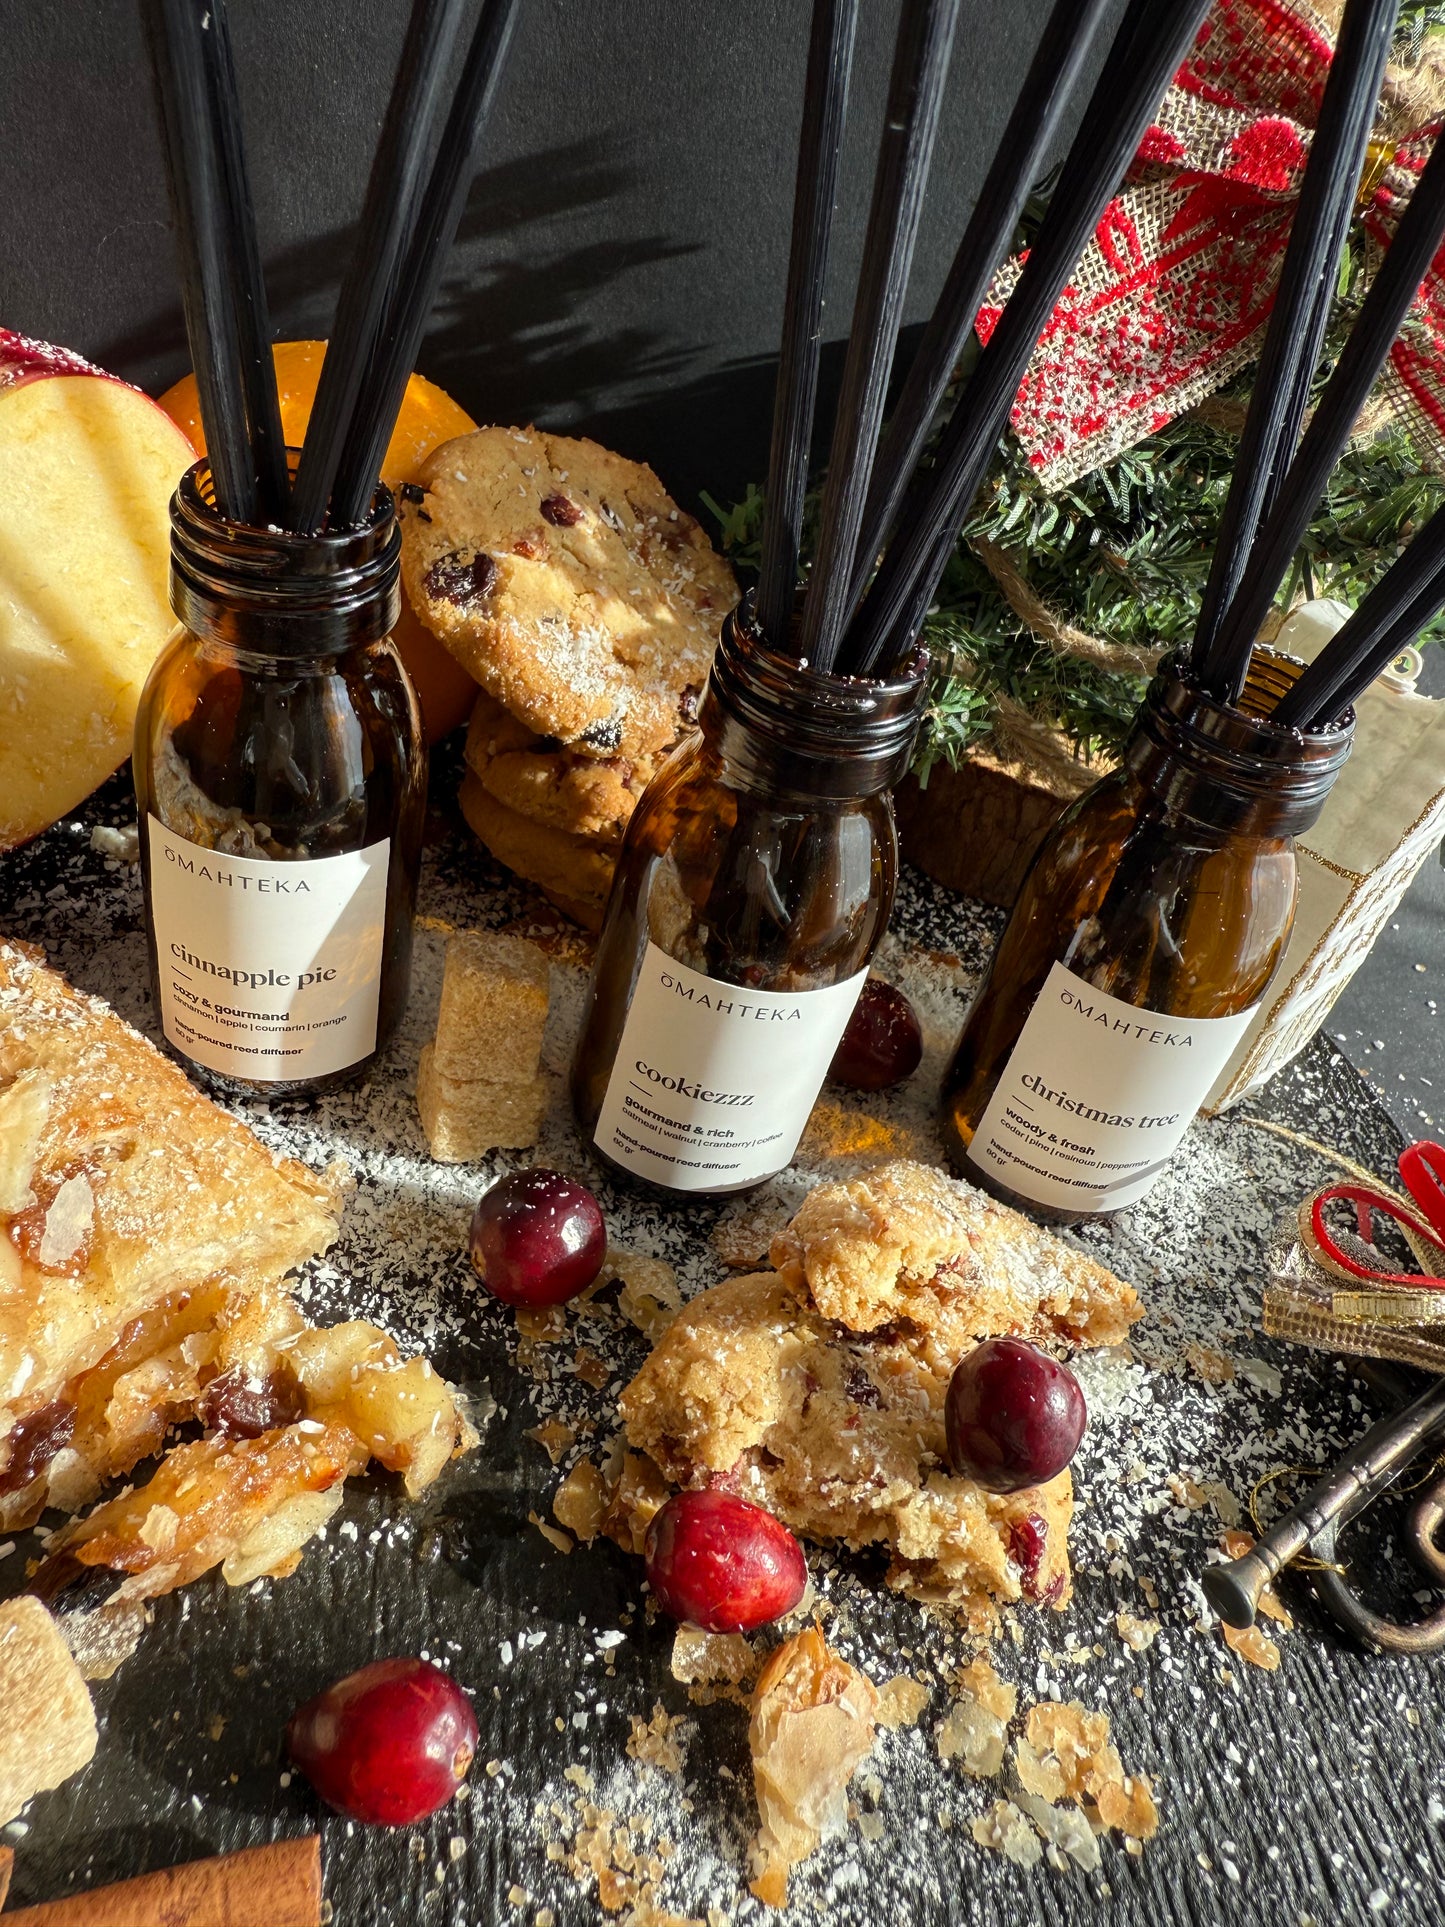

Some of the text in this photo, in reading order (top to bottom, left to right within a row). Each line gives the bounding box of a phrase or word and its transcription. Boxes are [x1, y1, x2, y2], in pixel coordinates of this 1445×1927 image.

[170, 944, 337, 990] cinnapple pie
[173, 982, 289, 1021] cozy & gourmand
[174, 996, 214, 1020] cinnamon
[220, 1019, 248, 1030] apple
[313, 1015, 347, 1029] orange
[175, 1017, 232, 1050] hand-poured
[234, 1046, 258, 1054] reed
[635, 1060, 755, 1106] cookiezzz
[1021, 1073, 1180, 1129] christmas tree
[622, 1107, 657, 1134] oatmeal
[663, 1132, 697, 1145] walnut
[703, 1139, 751, 1149] cranberry
[757, 1132, 783, 1145] coffee
[625, 1096, 734, 1138] gourmand & rich
[1005, 1107, 1095, 1155] woody & fresh
[615, 1128, 741, 1170] hand-poured reed diffuser
[990, 1139, 1110, 1190] hand-poured reed diffuser
[1000, 1118, 1024, 1140] cedar
[1030, 1139, 1050, 1153] pine
[1055, 1149, 1096, 1168] resinous
[1101, 1159, 1150, 1170] peppermint
